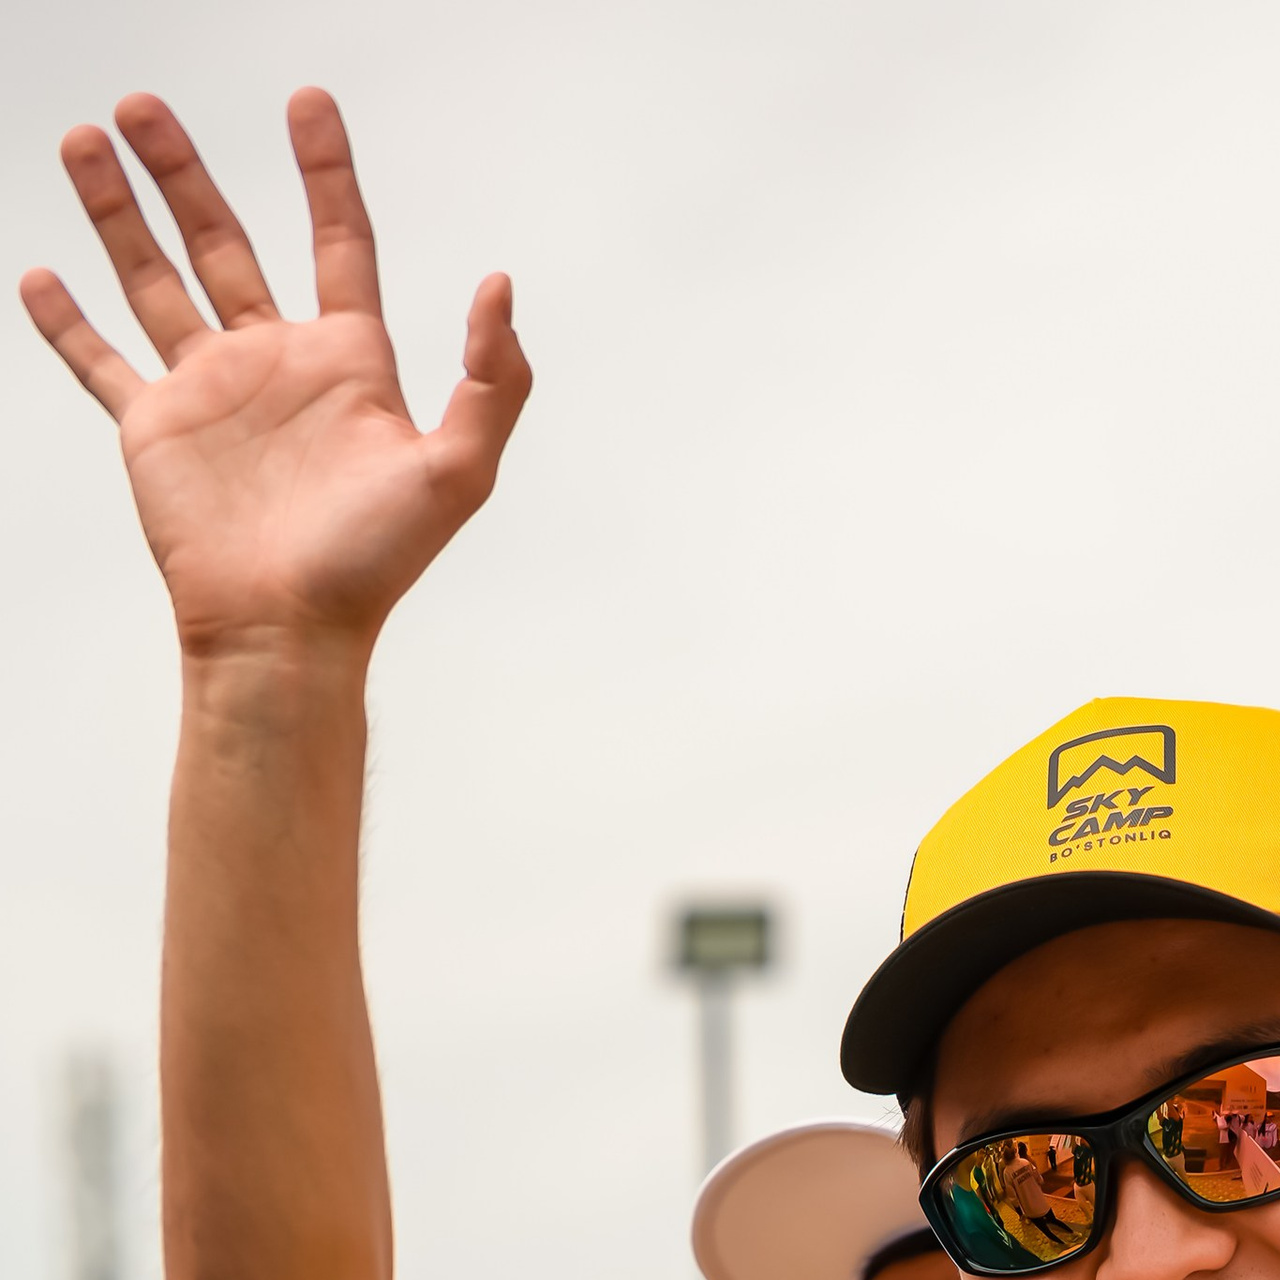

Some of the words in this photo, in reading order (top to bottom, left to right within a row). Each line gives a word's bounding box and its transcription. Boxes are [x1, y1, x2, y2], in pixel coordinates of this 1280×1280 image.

[1061, 786, 1155, 823] SKY
[1049, 806, 1173, 847] CAMP
[1050, 829, 1171, 863] BO'STONLIQ
